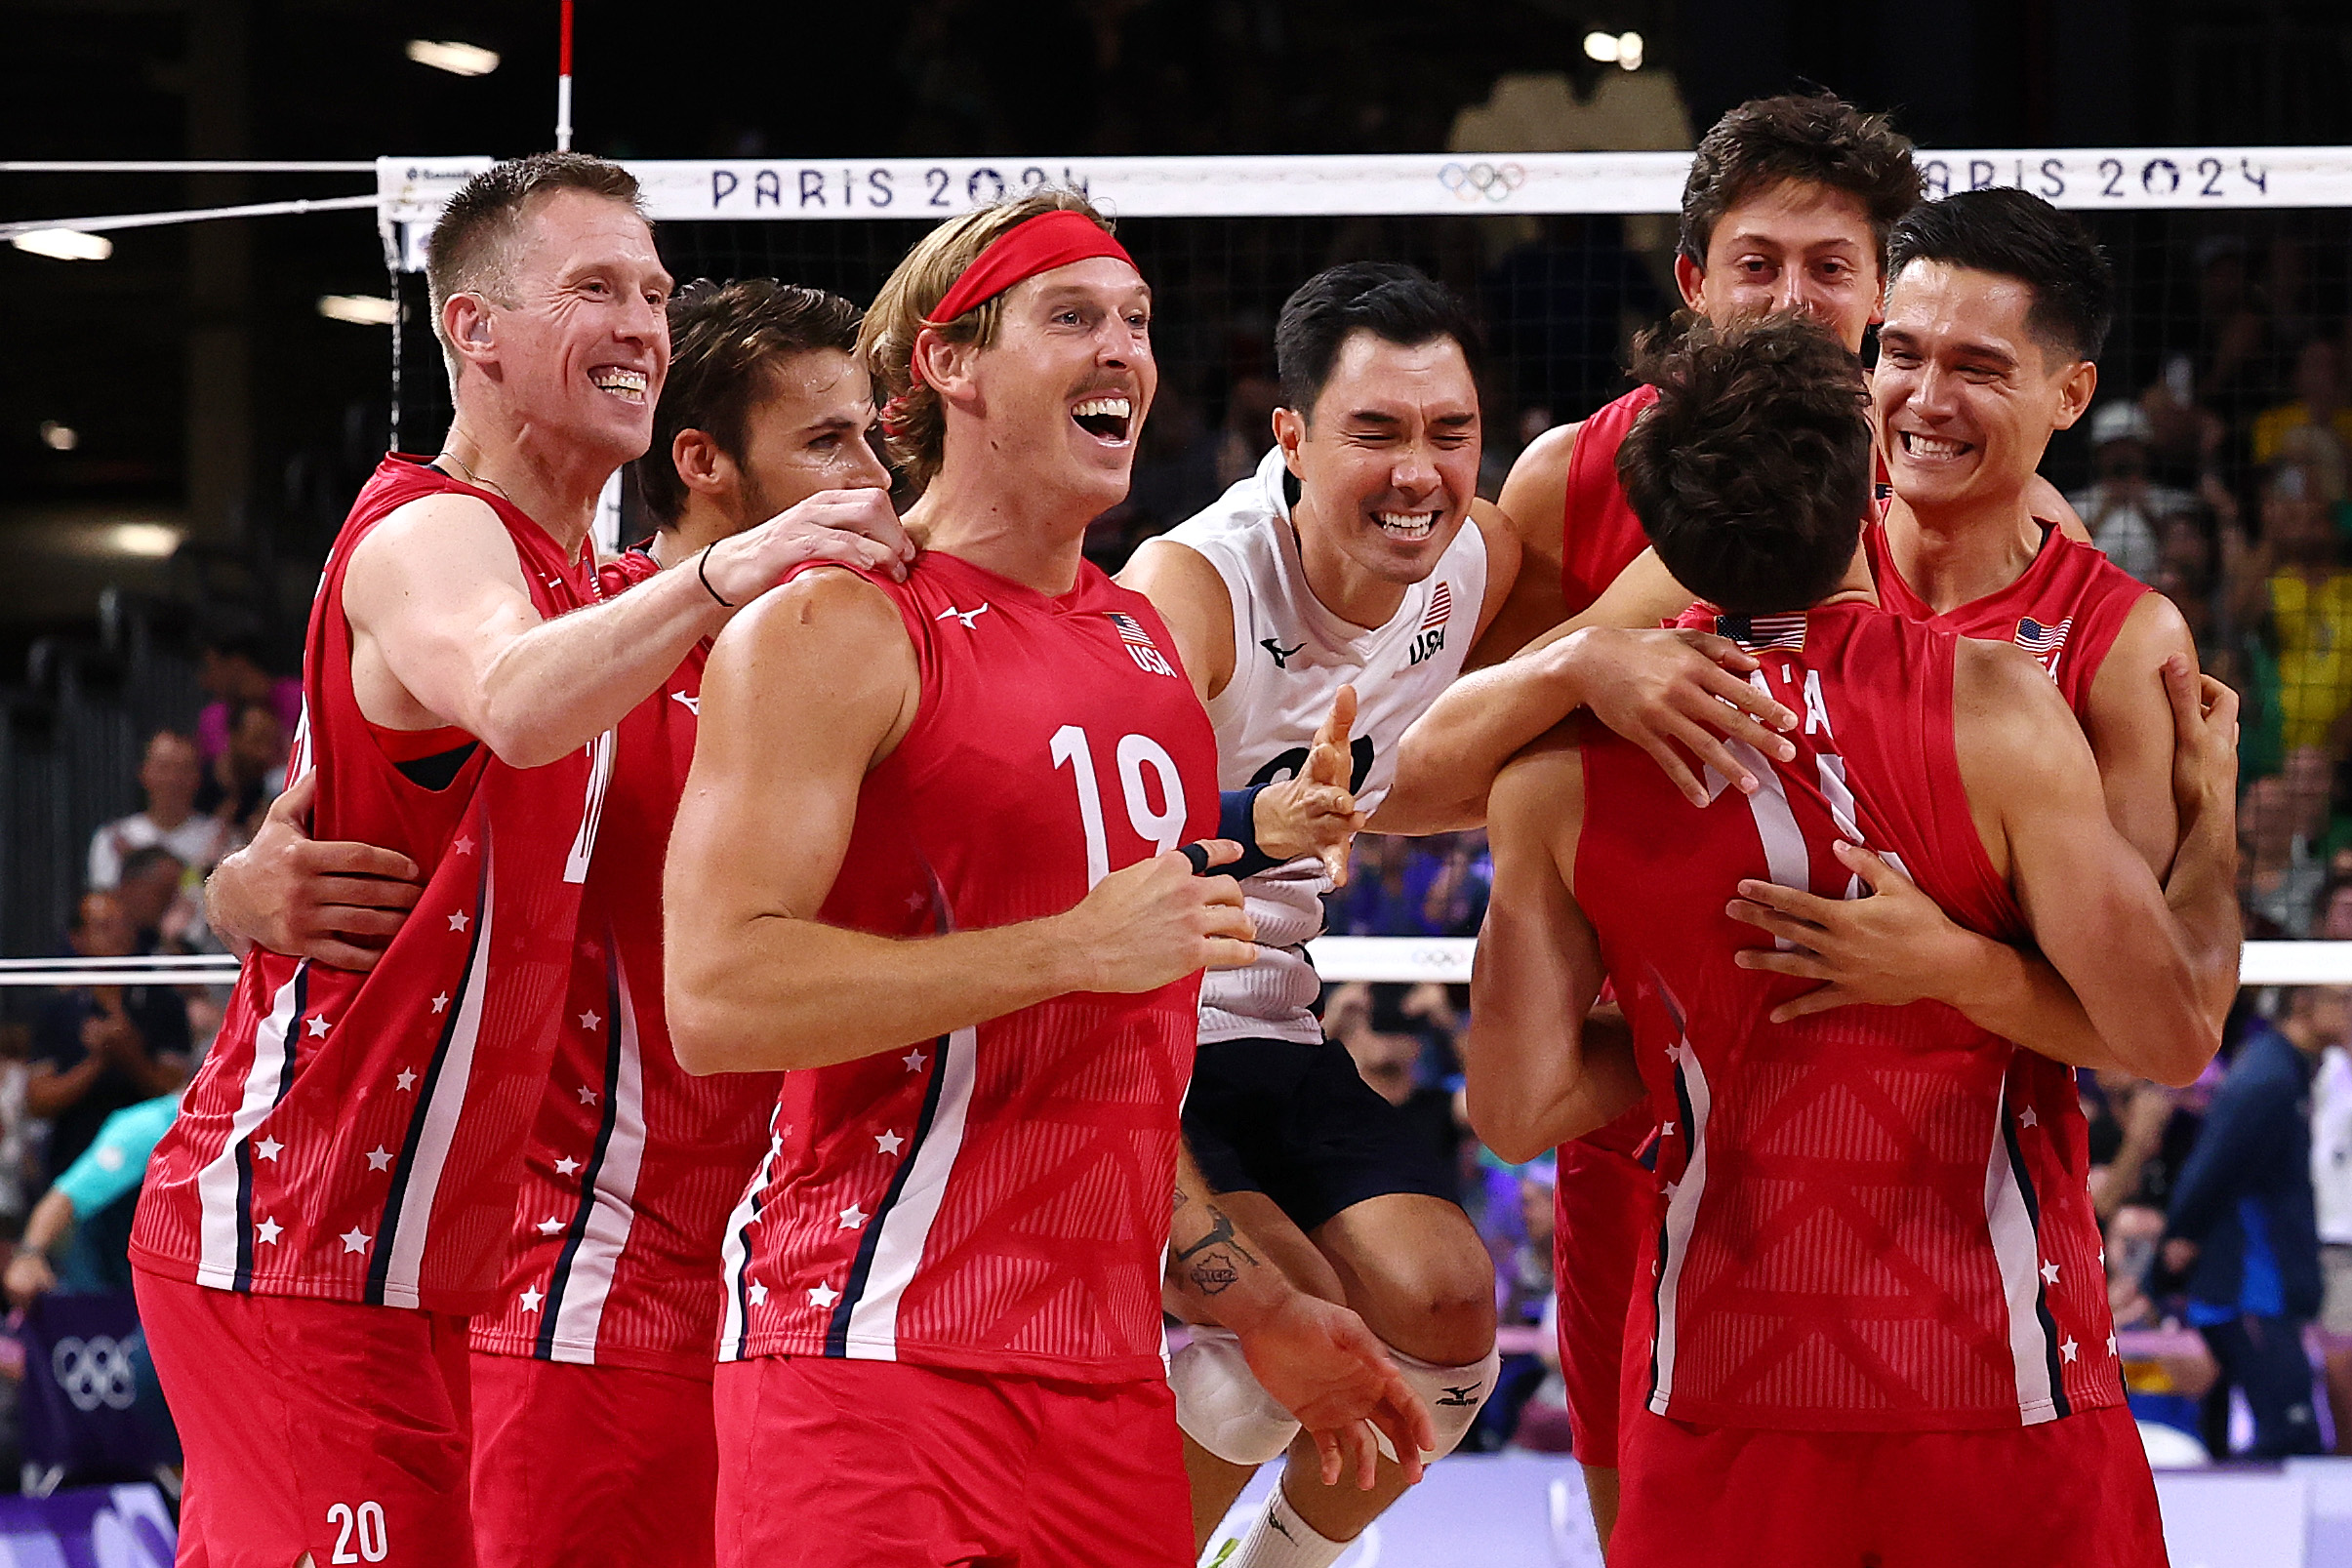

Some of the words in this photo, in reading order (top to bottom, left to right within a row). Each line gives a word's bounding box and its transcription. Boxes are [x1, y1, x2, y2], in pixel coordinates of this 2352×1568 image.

[711, 167, 895, 210] PARIS
[1923, 158, 2064, 197] ARIS
[2098, 157, 2267, 197] 2024
[1124, 643, 1178, 679] USA
[1409, 624, 1446, 665] USA
[1049, 724, 1188, 893] 19
[326, 1501, 388, 1565] 20
